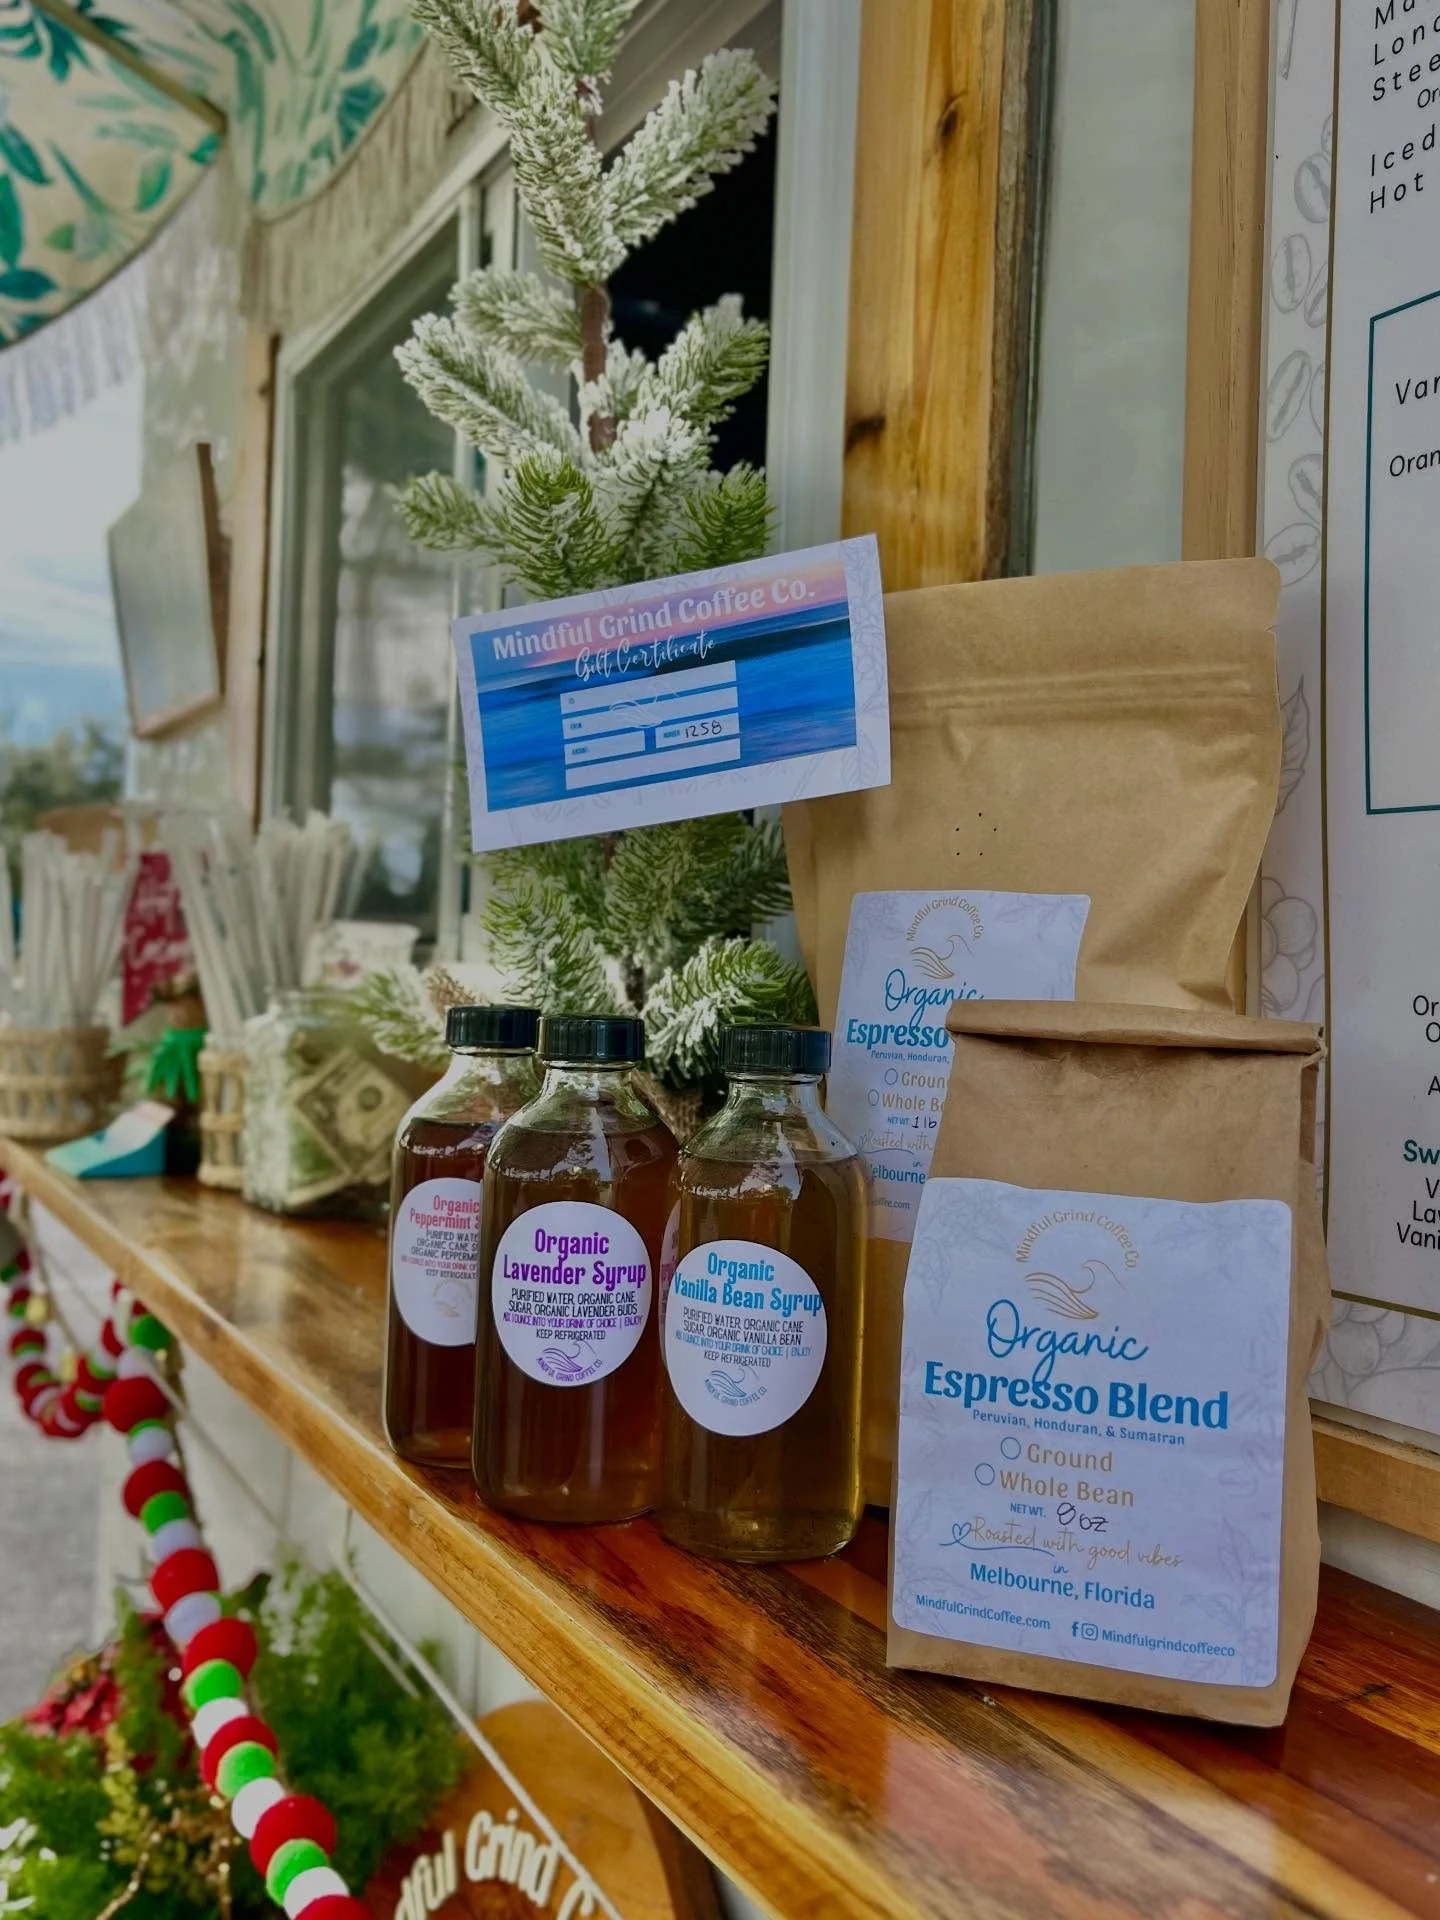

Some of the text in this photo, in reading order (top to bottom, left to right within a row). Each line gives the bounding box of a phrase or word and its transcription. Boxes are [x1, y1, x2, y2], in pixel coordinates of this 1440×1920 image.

[1371, 124, 1435, 176] Iced
[1370, 172, 1424, 214] Hot
[492, 577, 816, 661] Mindful Grind Coffee Co.
[616, 629, 718, 674] Certificate
[684, 720, 724, 739] 1258
[932, 896, 959, 910] Grind
[847, 1018, 949, 1051] Espresso
[871, 1050, 951, 1065] Peruvian, Honduran,
[901, 1071, 949, 1090] Groun
[882, 1093, 927, 1113] Whole
[871, 1164, 927, 1186] elbourne
[409, 1208, 471, 1231] Peppermint
[433, 1195, 480, 1217] Organic
[535, 1228, 609, 1262] Organic
[1015, 1214, 1053, 1263] Mindful
[1053, 1208, 1096, 1224] Grind
[1096, 1214, 1133, 1250] Coffee
[504, 1255, 647, 1291] Lavender Syrup
[707, 1252, 774, 1284] Organic
[511, 1288, 544, 1303] PURIFIED
[577, 1292, 614, 1305] ORGANIC
[616, 1291, 636, 1303] CANE
[674, 1272, 717, 1304] Vanilla
[722, 1282, 764, 1310] Bean
[770, 1288, 823, 1317] Syrup
[534, 1303, 570, 1317] ORGANIC
[572, 1305, 615, 1318] LAVENDER
[617, 1303, 638, 1316] BUDS
[683, 1307, 713, 1325] PURIFIED
[743, 1318, 780, 1332] ORGANIC
[782, 1321, 804, 1333] CANE
[536, 1329, 606, 1341] KEEP REFRIGERATED
[707, 1326, 741, 1342] ORGANIC
[743, 1331, 778, 1346] VANILLA
[779, 1333, 802, 1346] BEAN
[986, 1298, 1149, 1386] Organic
[704, 1350, 771, 1368] KEEP REFRIGERATED
[924, 1361, 1230, 1430] Espresso Blend
[972, 1408, 1186, 1447] Peruvian, Honduran, & Sumatran
[1027, 1443, 1114, 1473] Ground
[1000, 1470, 1136, 1507] Whole Bean
[1009, 1502, 1027, 1515] NET
[973, 1516, 1185, 1570] Roasted with good vibes
[1052, 1562, 1070, 1576] in
[969, 1562, 1156, 1610] Melbourne, Florida
[915, 1594, 1052, 1631] MindfulGrindCoffee.com
[1101, 1629, 1236, 1658] Mindfulgrindcoffeeco
[465, 1807, 559, 1909] Grind
